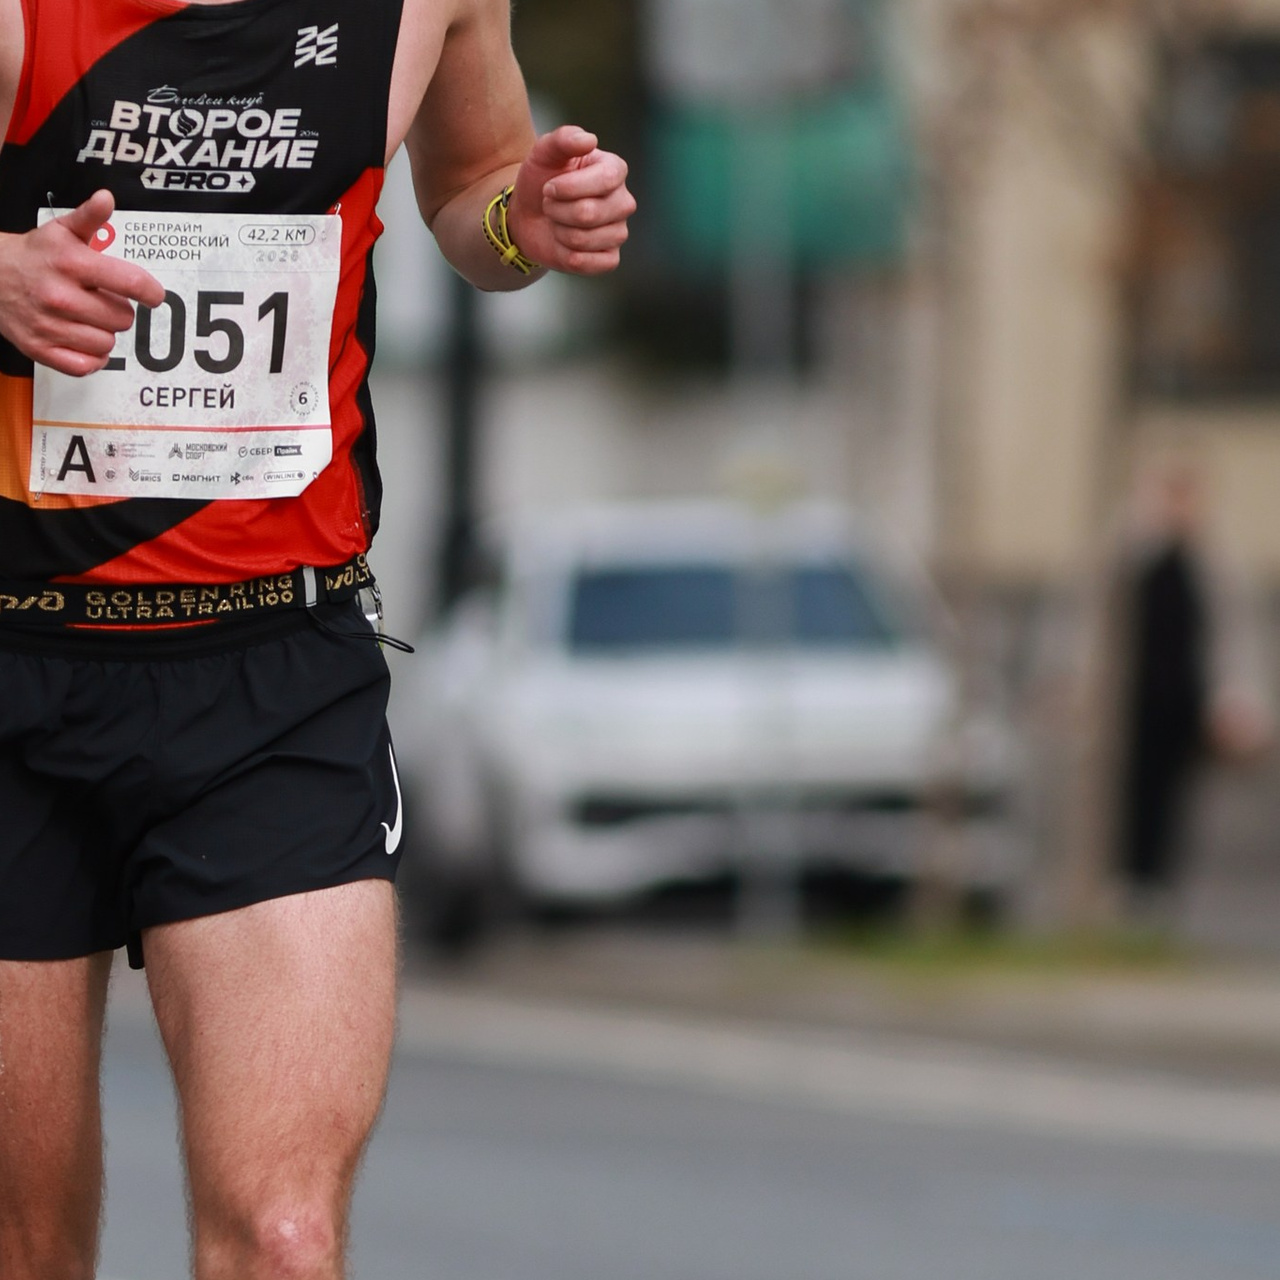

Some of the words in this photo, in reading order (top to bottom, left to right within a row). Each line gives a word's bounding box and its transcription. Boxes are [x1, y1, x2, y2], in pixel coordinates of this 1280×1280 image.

[226, 92, 264, 110] клуб
[109, 100, 302, 138] ВТОРОЕ
[76, 129, 319, 169] ДЫХАНИЕ
[163, 171, 231, 190] PRO
[124, 222, 202, 233] СБЕРПРАЙМ
[247, 228, 280, 243] 42,2
[285, 228, 307, 241] КМ
[124, 234, 230, 247] МОСКОВСКИЙ
[124, 248, 201, 261] МАРАФОН
[100, 290, 289, 375] 051
[139, 384, 235, 410] СЕРГЕЙ
[298, 391, 308, 405] 6
[185, 442, 228, 452] МОСКОВСКИЙ
[249, 447, 272, 456] СБЕР
[56, 435, 97, 483] A
[185, 452, 205, 460] СПОРТ
[266, 473, 295, 481] WINLINE
[86, 586, 219, 607] GOLDEN
[230, 575, 294, 598] RING
[86, 605, 175, 619] ULTRA
[180, 599, 254, 617] TRAIL
[257, 589, 294, 607] 100
